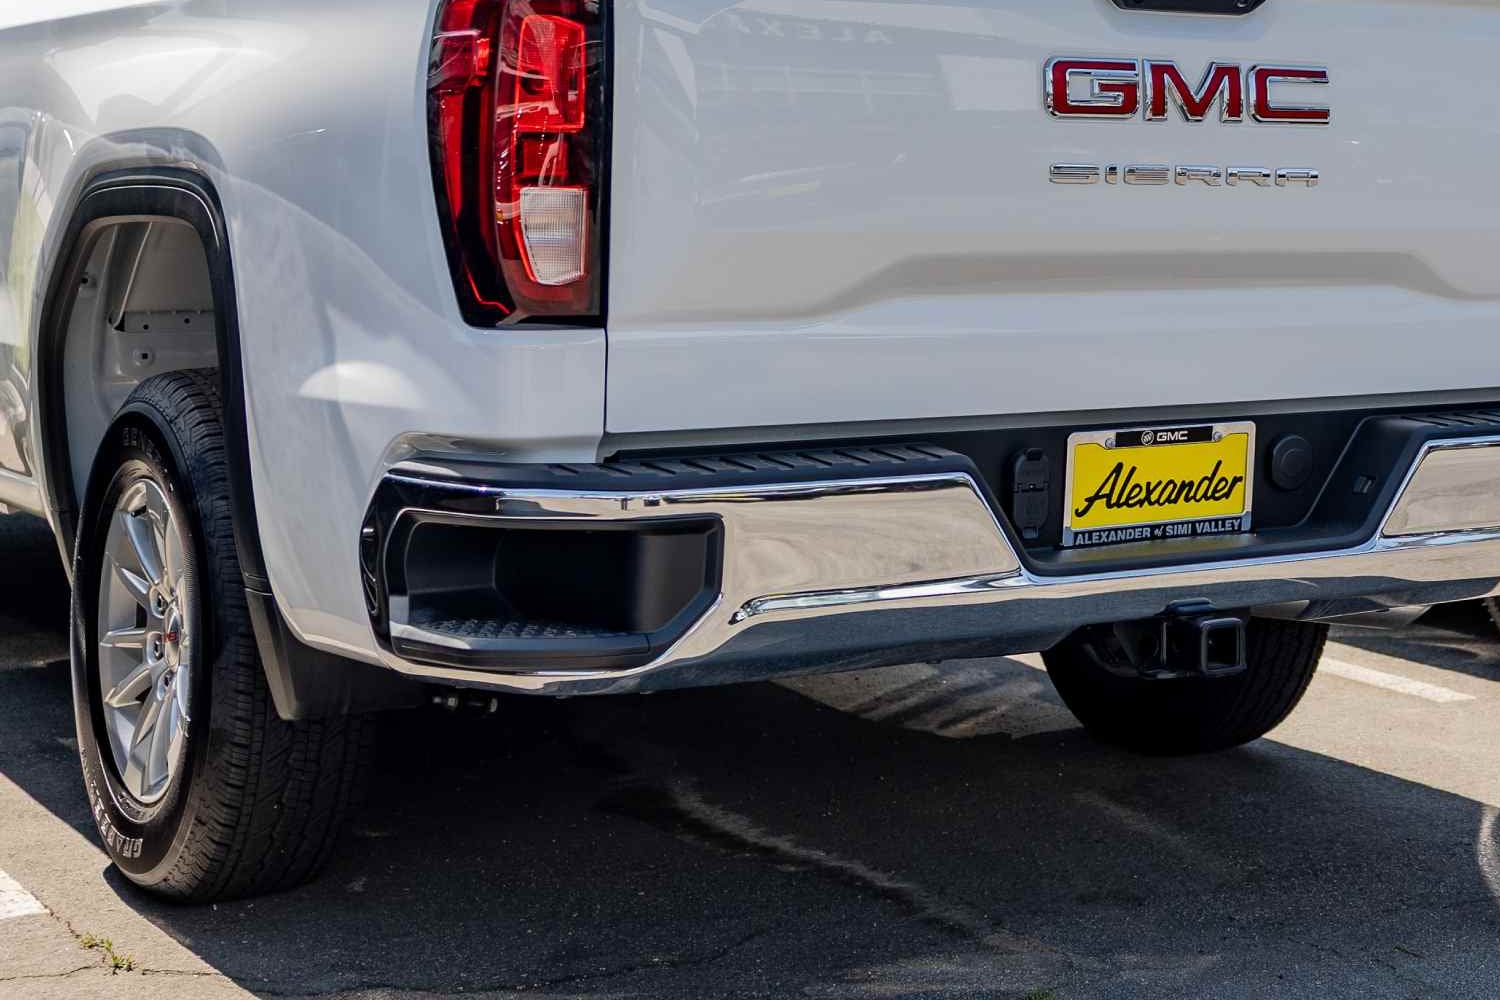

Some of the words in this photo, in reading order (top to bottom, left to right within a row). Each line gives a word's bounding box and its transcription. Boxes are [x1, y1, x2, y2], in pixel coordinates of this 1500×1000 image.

[1045, 56, 1330, 123] GMC
[1049, 162, 1320, 187] SIERRA
[1156, 430, 1189, 442] GMC
[1074, 460, 1244, 518] Alexander
[1075, 526, 1151, 546] ALEXANDER
[1165, 522, 1192, 537] SIMI
[1195, 518, 1241, 534] VALLEY
